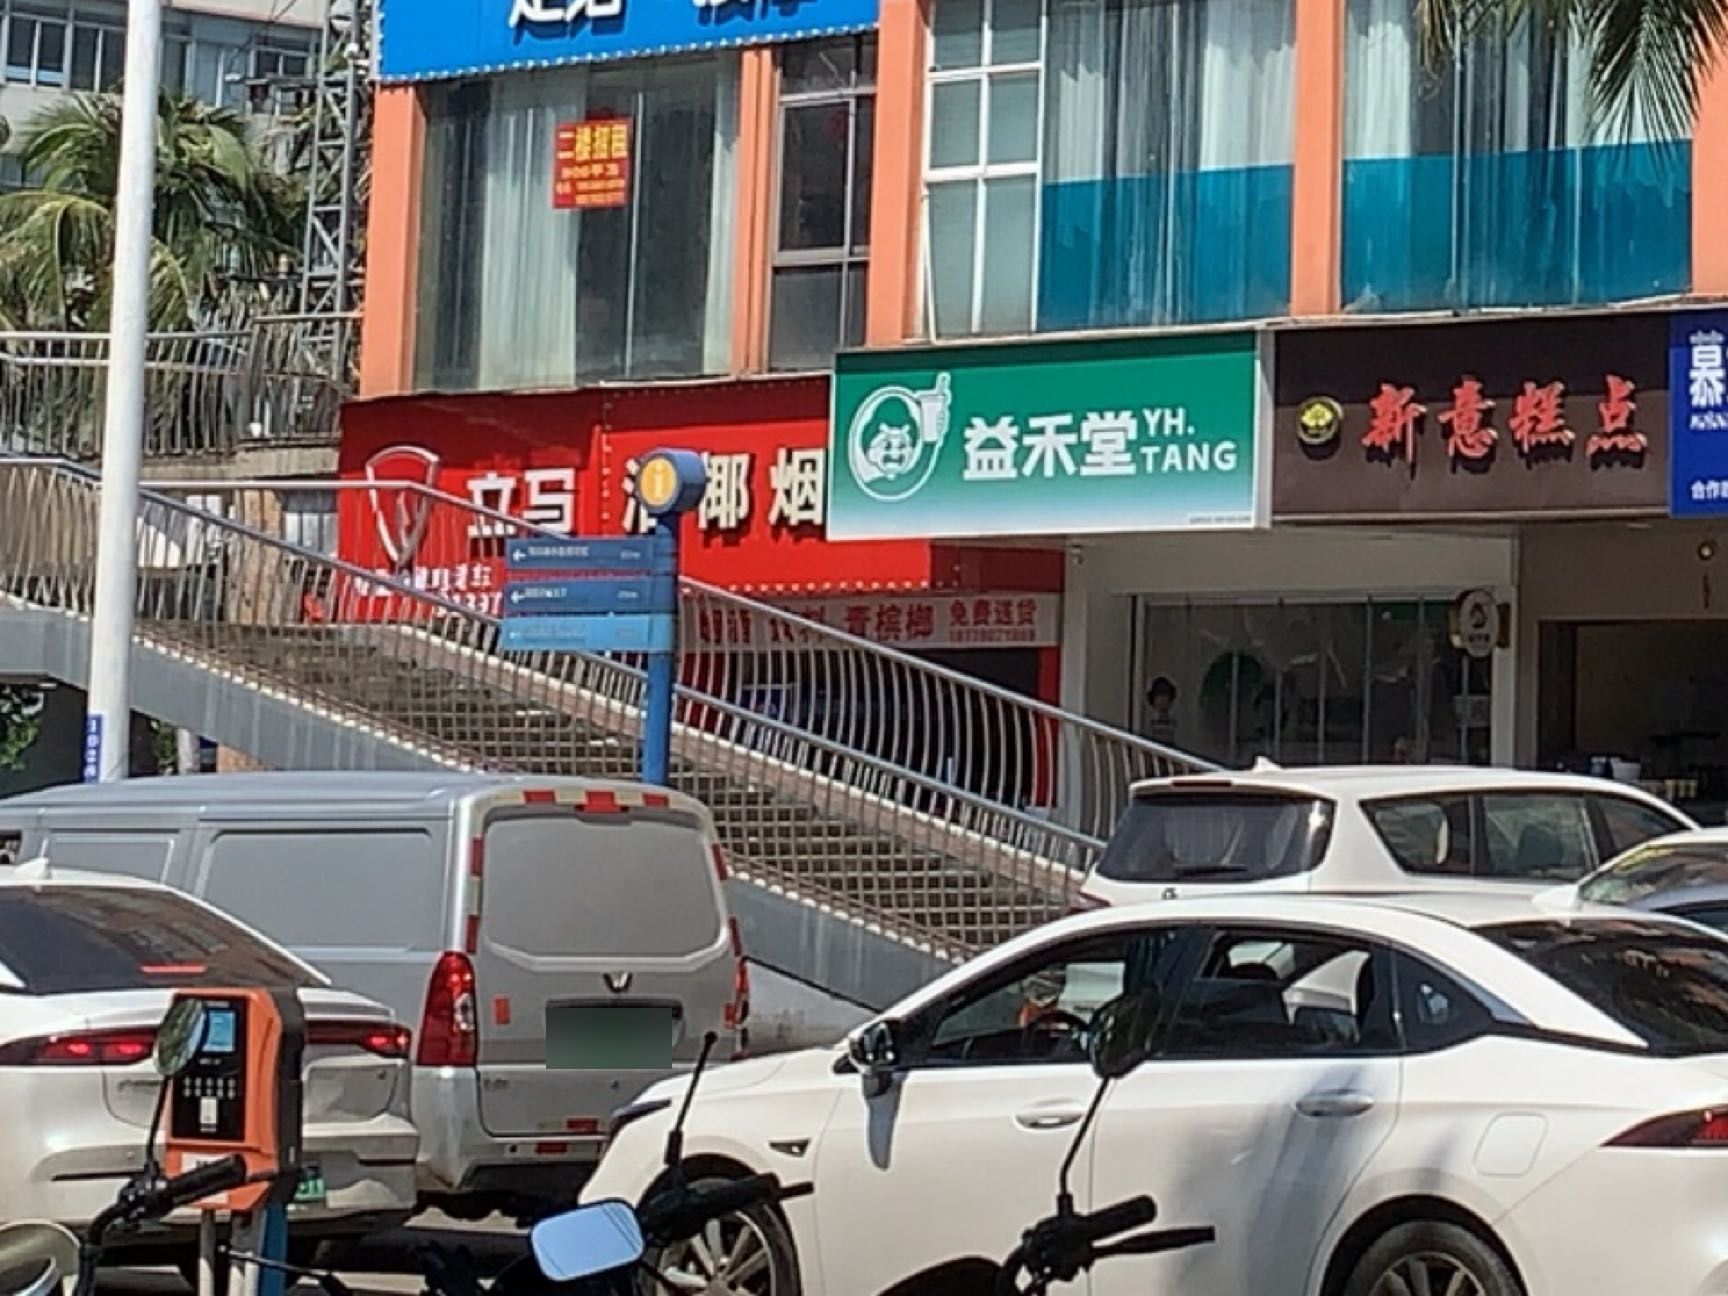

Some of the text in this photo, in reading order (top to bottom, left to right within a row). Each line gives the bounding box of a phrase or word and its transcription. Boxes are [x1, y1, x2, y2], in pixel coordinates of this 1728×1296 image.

[1143, 407, 1195, 438] YH.
[1361, 373, 1648, 461] 新意糕点
[963, 410, 1138, 481] 益禾堂
[1141, 441, 1239, 474] TANG
